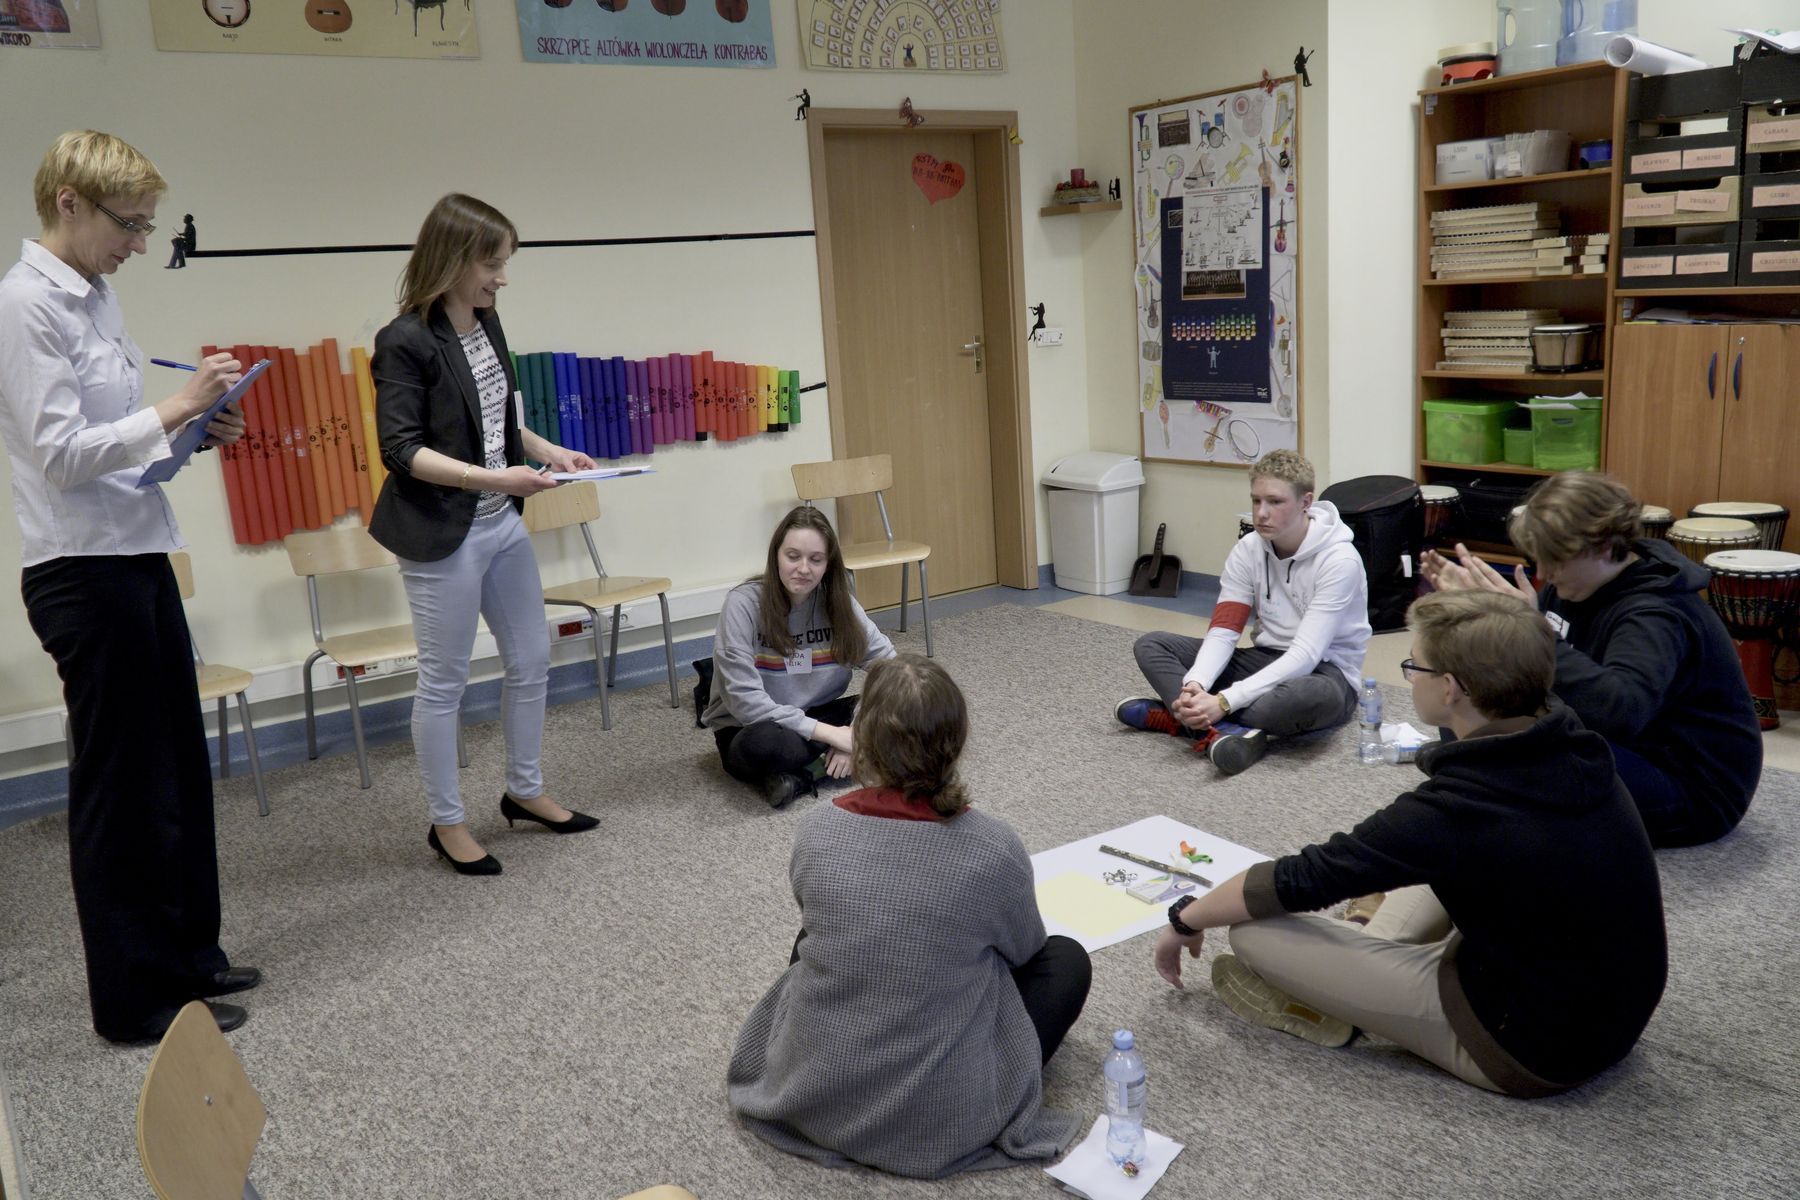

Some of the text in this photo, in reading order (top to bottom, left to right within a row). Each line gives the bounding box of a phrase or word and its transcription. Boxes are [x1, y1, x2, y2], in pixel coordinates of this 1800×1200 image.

[537, 36, 768, 61] SKRZYPCE ALTÓWKA WIOLONCZELA KONTRABAS
[806, 627, 833, 644] COV
